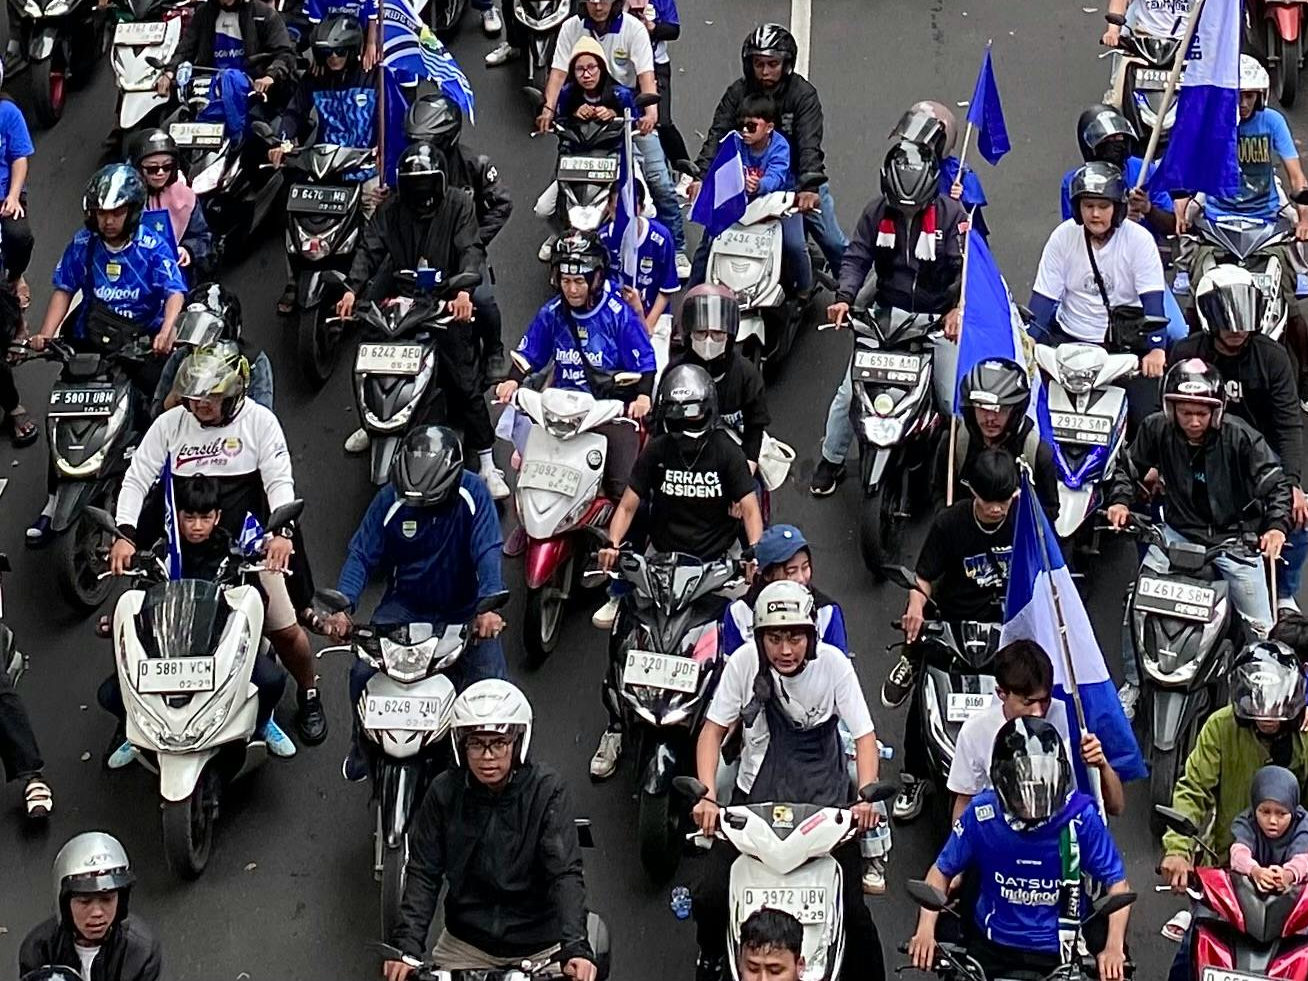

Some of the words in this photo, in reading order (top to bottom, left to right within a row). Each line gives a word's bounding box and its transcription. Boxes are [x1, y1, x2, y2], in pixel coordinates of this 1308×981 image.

[93, 285, 141, 302] dofood
[371, 347, 396, 358] 6242
[65, 392, 90, 404] 5801
[1057, 415, 1086, 428] 2932
[1154, 584, 1183, 599] 4612
[141, 662, 149, 676] D
[156, 662, 184, 676] 5881
[368, 700, 376, 712] D
[384, 700, 411, 714] 6248
[418, 700, 438, 715] ZAU
[745, 890, 754, 904] D
[762, 890, 794, 905] 3972
[801, 890, 825, 904] UBV
[797, 911, 825, 921] 2-29
